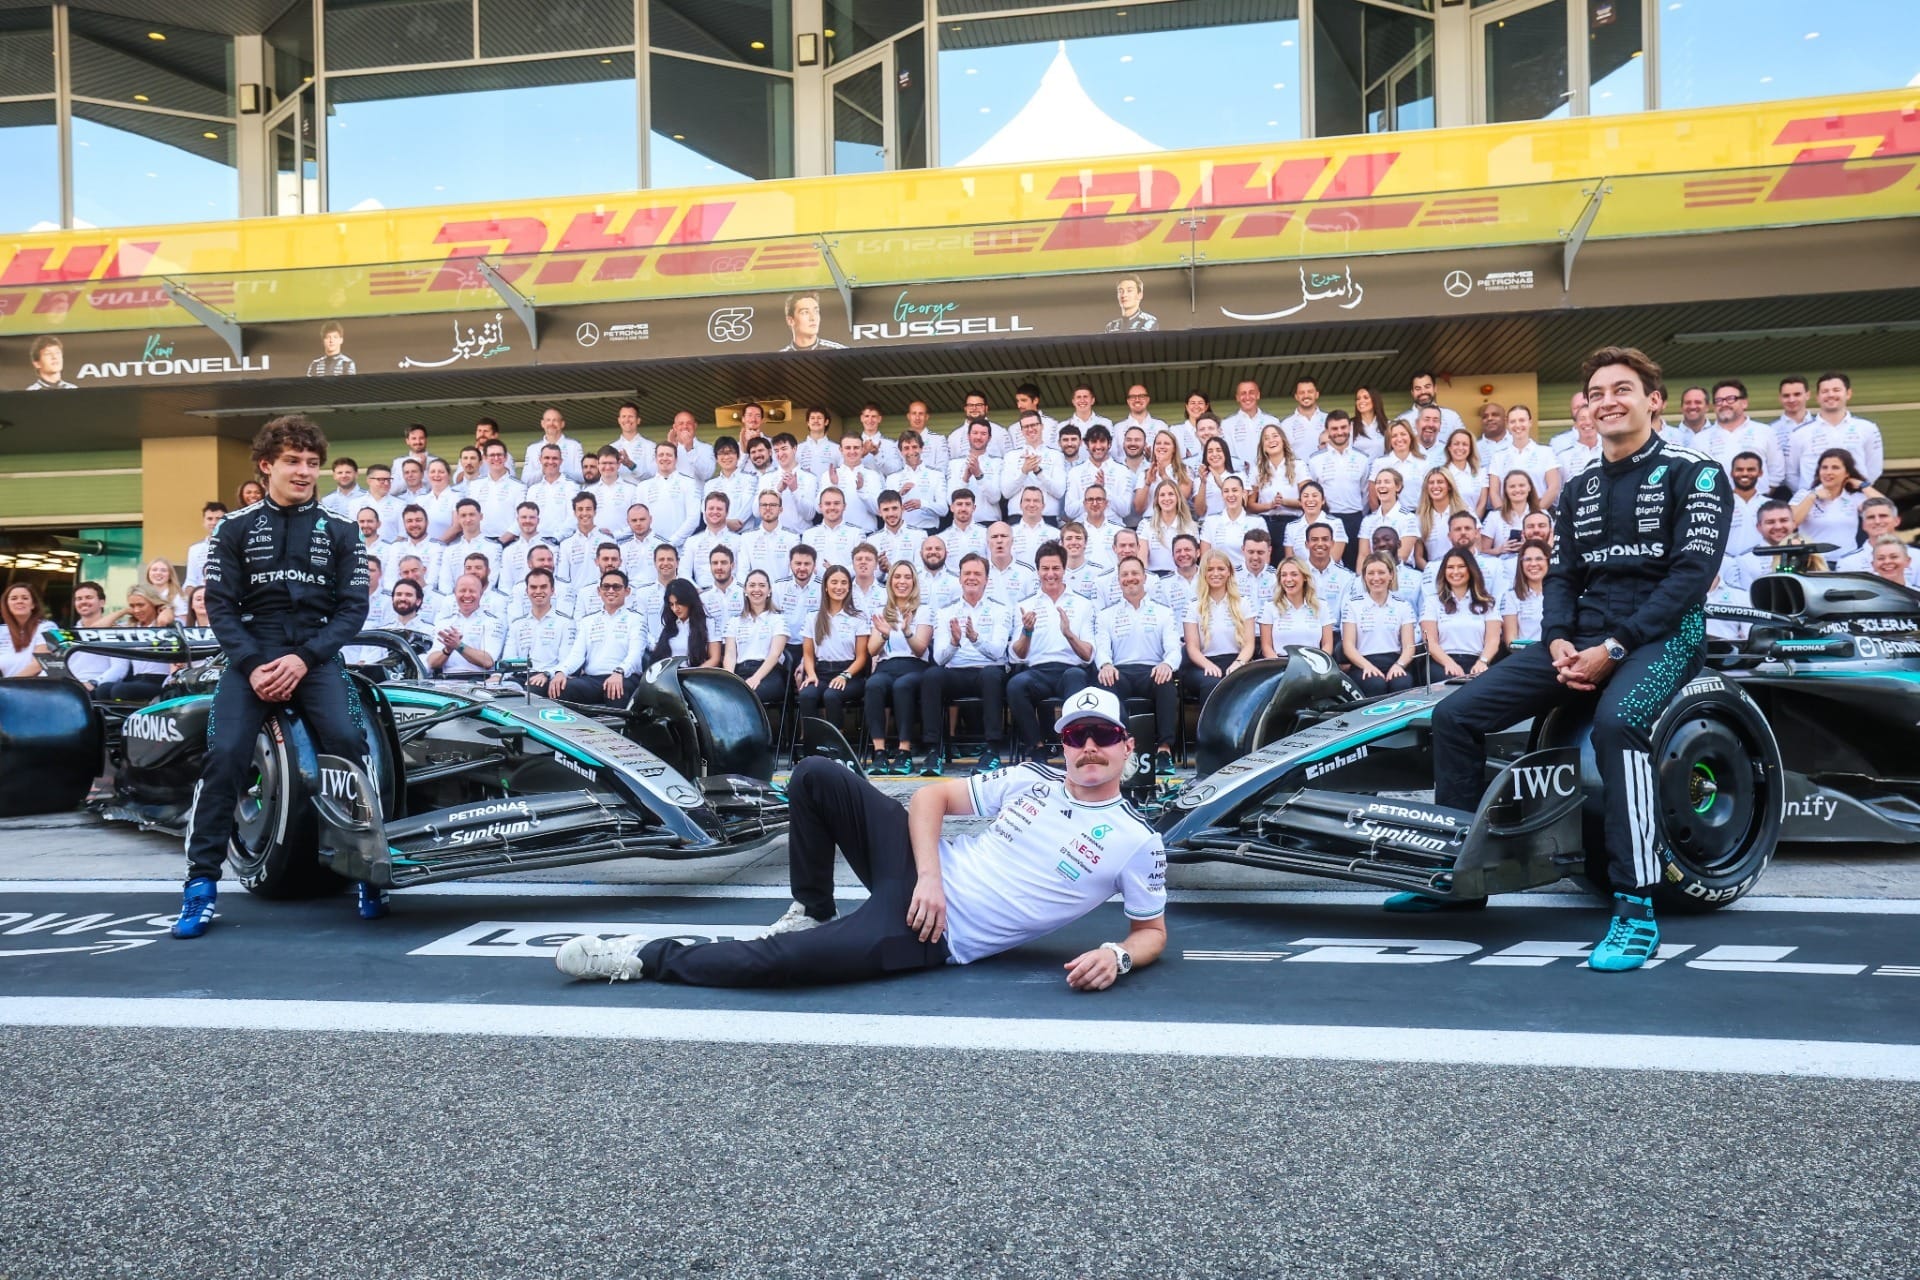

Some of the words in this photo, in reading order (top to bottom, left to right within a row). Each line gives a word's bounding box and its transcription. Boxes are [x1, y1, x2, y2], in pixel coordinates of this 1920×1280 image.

[1040, 152, 1424, 251] DHL
[427, 202, 757, 292] DHL
[0, 241, 175, 316] HL
[1477, 278, 1533, 286] PETRONAS
[707, 306, 753, 343] 63
[894, 291, 960, 335] George
[603, 329, 648, 337] PETRONAS
[853, 315, 1033, 340] RUSSELL
[142, 334, 174, 362] Kimi
[76, 355, 270, 379] ANTONELLI
[1688, 492, 1720, 502] PETRONAS
[1693, 502, 1722, 513] SOLERA
[1691, 513, 1716, 524] IWC
[256, 535, 272, 543] UBS
[1686, 527, 1710, 538] AMD
[1581, 543, 1664, 562] PETONAS
[250, 570, 326, 585] PETRONAS
[1706, 604, 1773, 620] CROWDSTRIKE
[78, 629, 216, 643] PETRONA
[1782, 644, 1826, 652] PETRONAS
[122, 715, 184, 743] ETRONAS
[554, 750, 597, 783] Einhell
[1305, 744, 1369, 781] Einhell
[321, 768, 358, 800] IWC
[1511, 764, 1576, 801] IWC
[449, 801, 527, 823] PETRONAS
[1021, 802, 1039, 817] UBS
[1368, 803, 1457, 826] PETRONAS
[1785, 796, 1838, 820] nify
[448, 821, 530, 845] Syntium
[1356, 818, 1448, 851] Syntium
[1283, 938, 1869, 975] DHL
